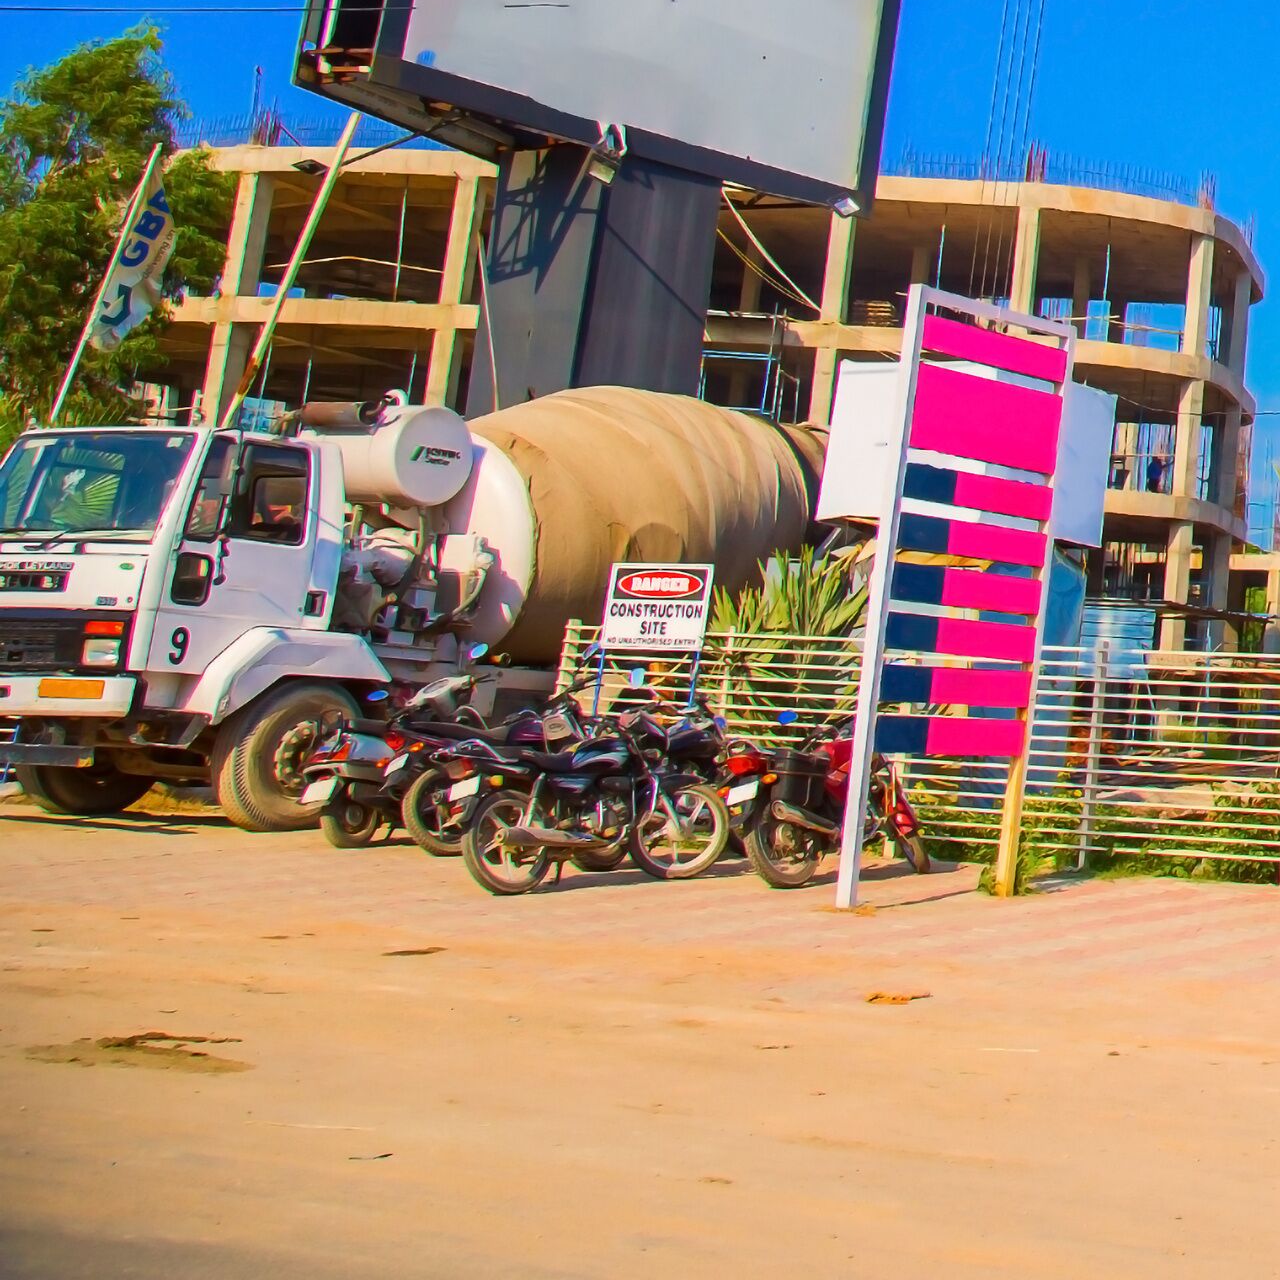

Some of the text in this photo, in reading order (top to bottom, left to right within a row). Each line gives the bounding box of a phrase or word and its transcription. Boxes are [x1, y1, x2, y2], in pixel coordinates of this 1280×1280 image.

[631, 577, 689, 592] DANGER
[610, 603, 703, 618] CONSTRUCTION
[640, 621, 667, 635] SITE
[169, 626, 190, 665] 9
